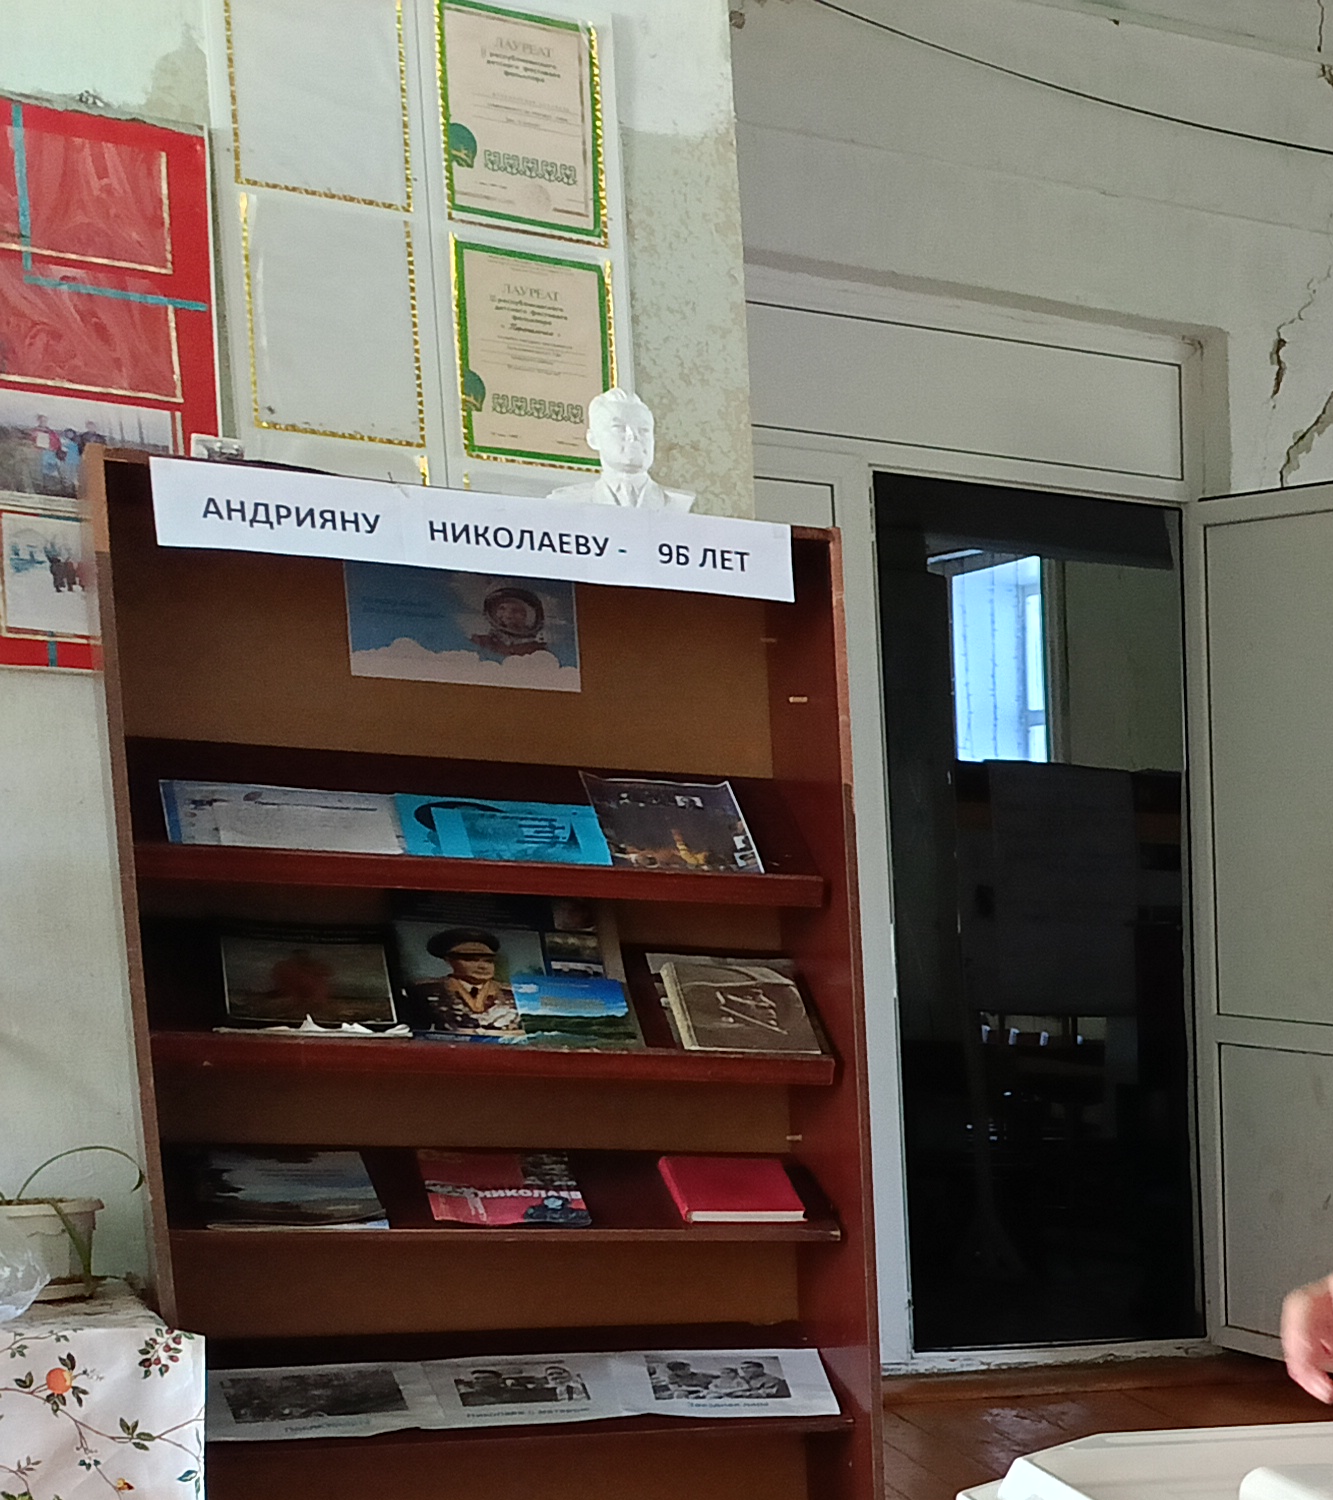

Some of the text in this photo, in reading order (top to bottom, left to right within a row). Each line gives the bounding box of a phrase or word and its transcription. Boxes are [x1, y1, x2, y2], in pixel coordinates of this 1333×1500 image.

[494, 36, 553, 58] ЛАУРЕАТ
[502, 283, 560, 301] ЛАУРЕАТ
[202, 497, 381, 535] АНДРИЯНУ
[428, 519, 610, 558] НИКОЛАЕВУ
[699, 548, 751, 573] ЛЕТ
